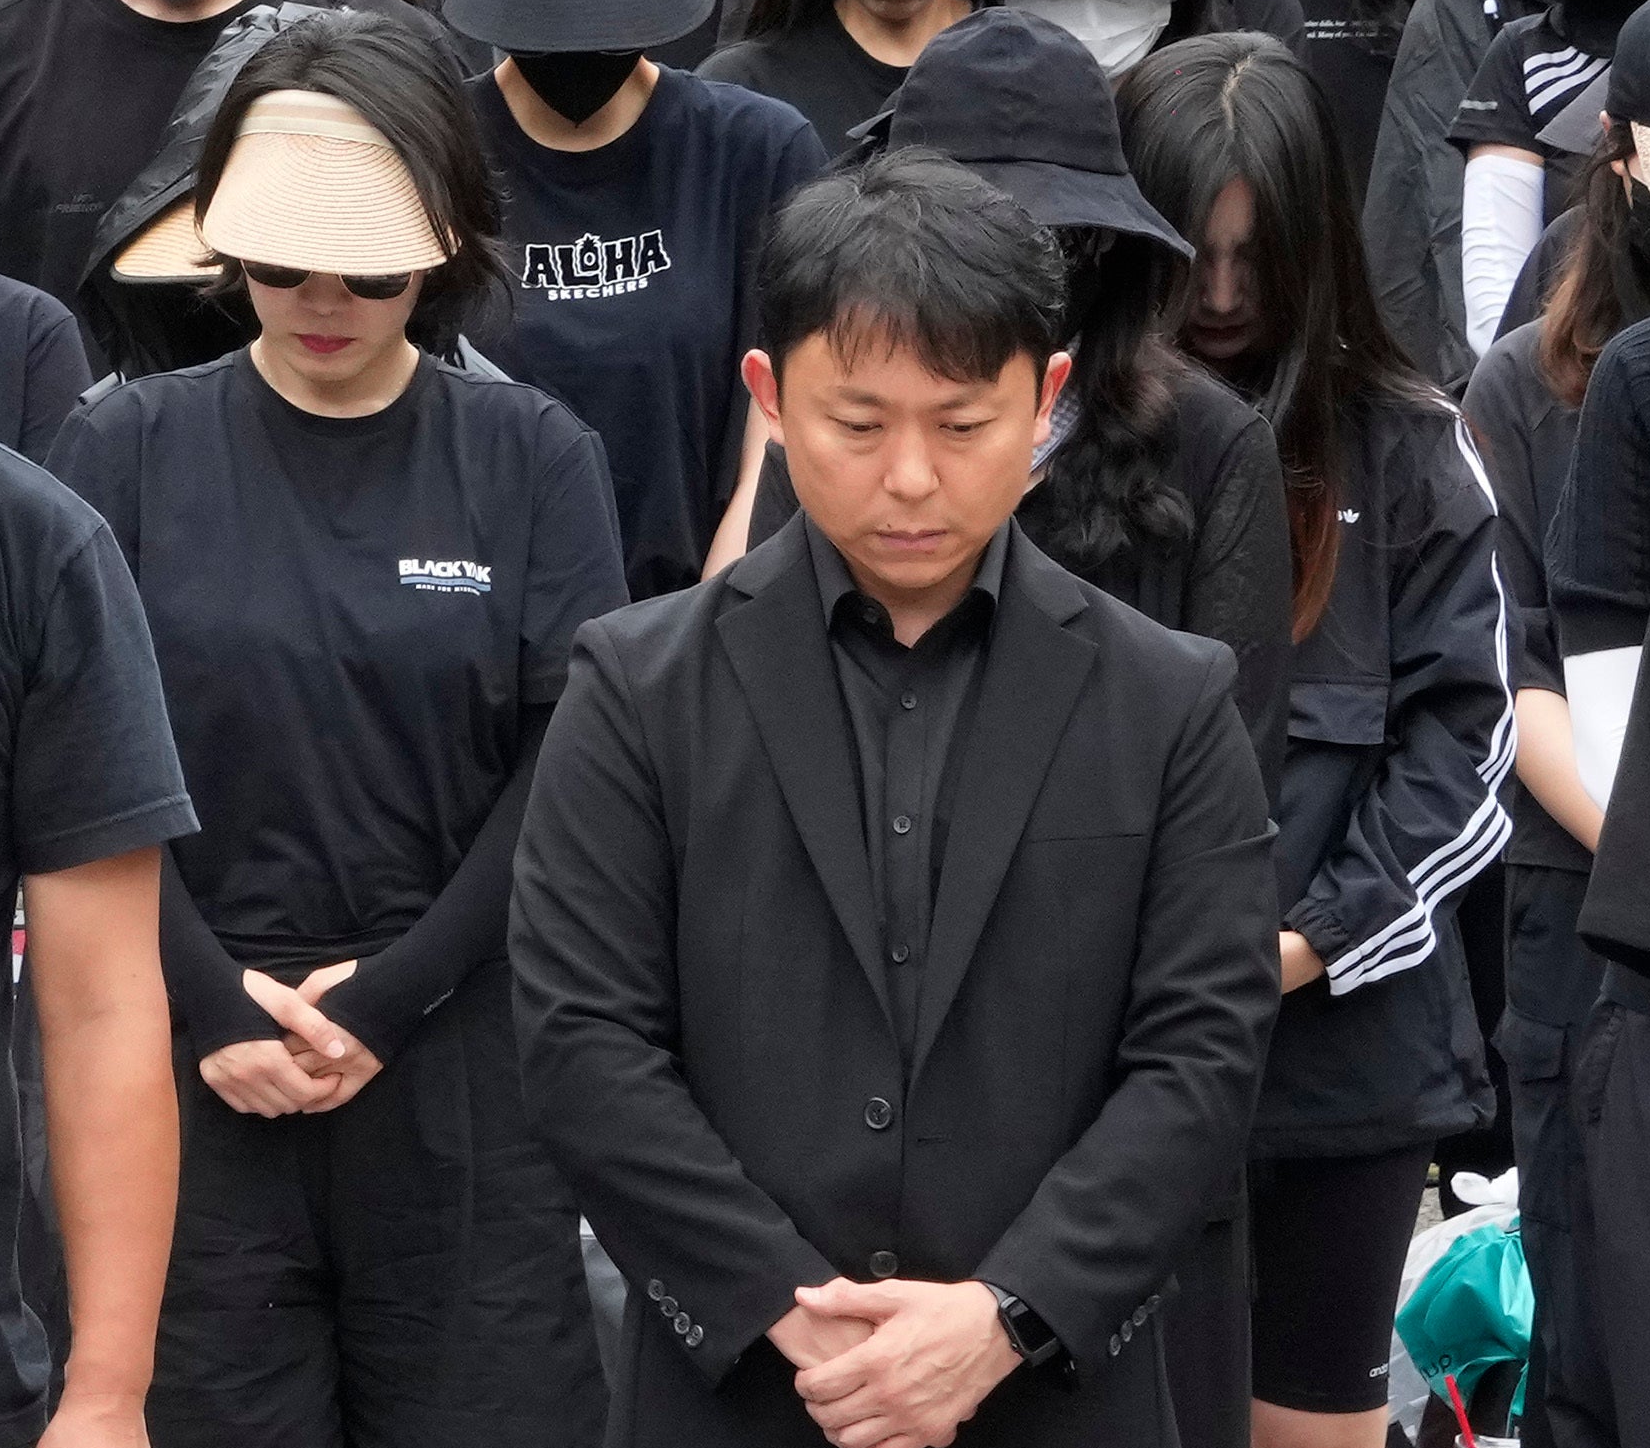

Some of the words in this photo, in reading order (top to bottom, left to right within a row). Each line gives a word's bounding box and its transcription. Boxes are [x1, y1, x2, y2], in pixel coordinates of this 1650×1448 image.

[522, 231, 671, 290] ALOHA
[547, 279, 649, 301] SKECHERS
[398, 559, 463, 578] BLACK
